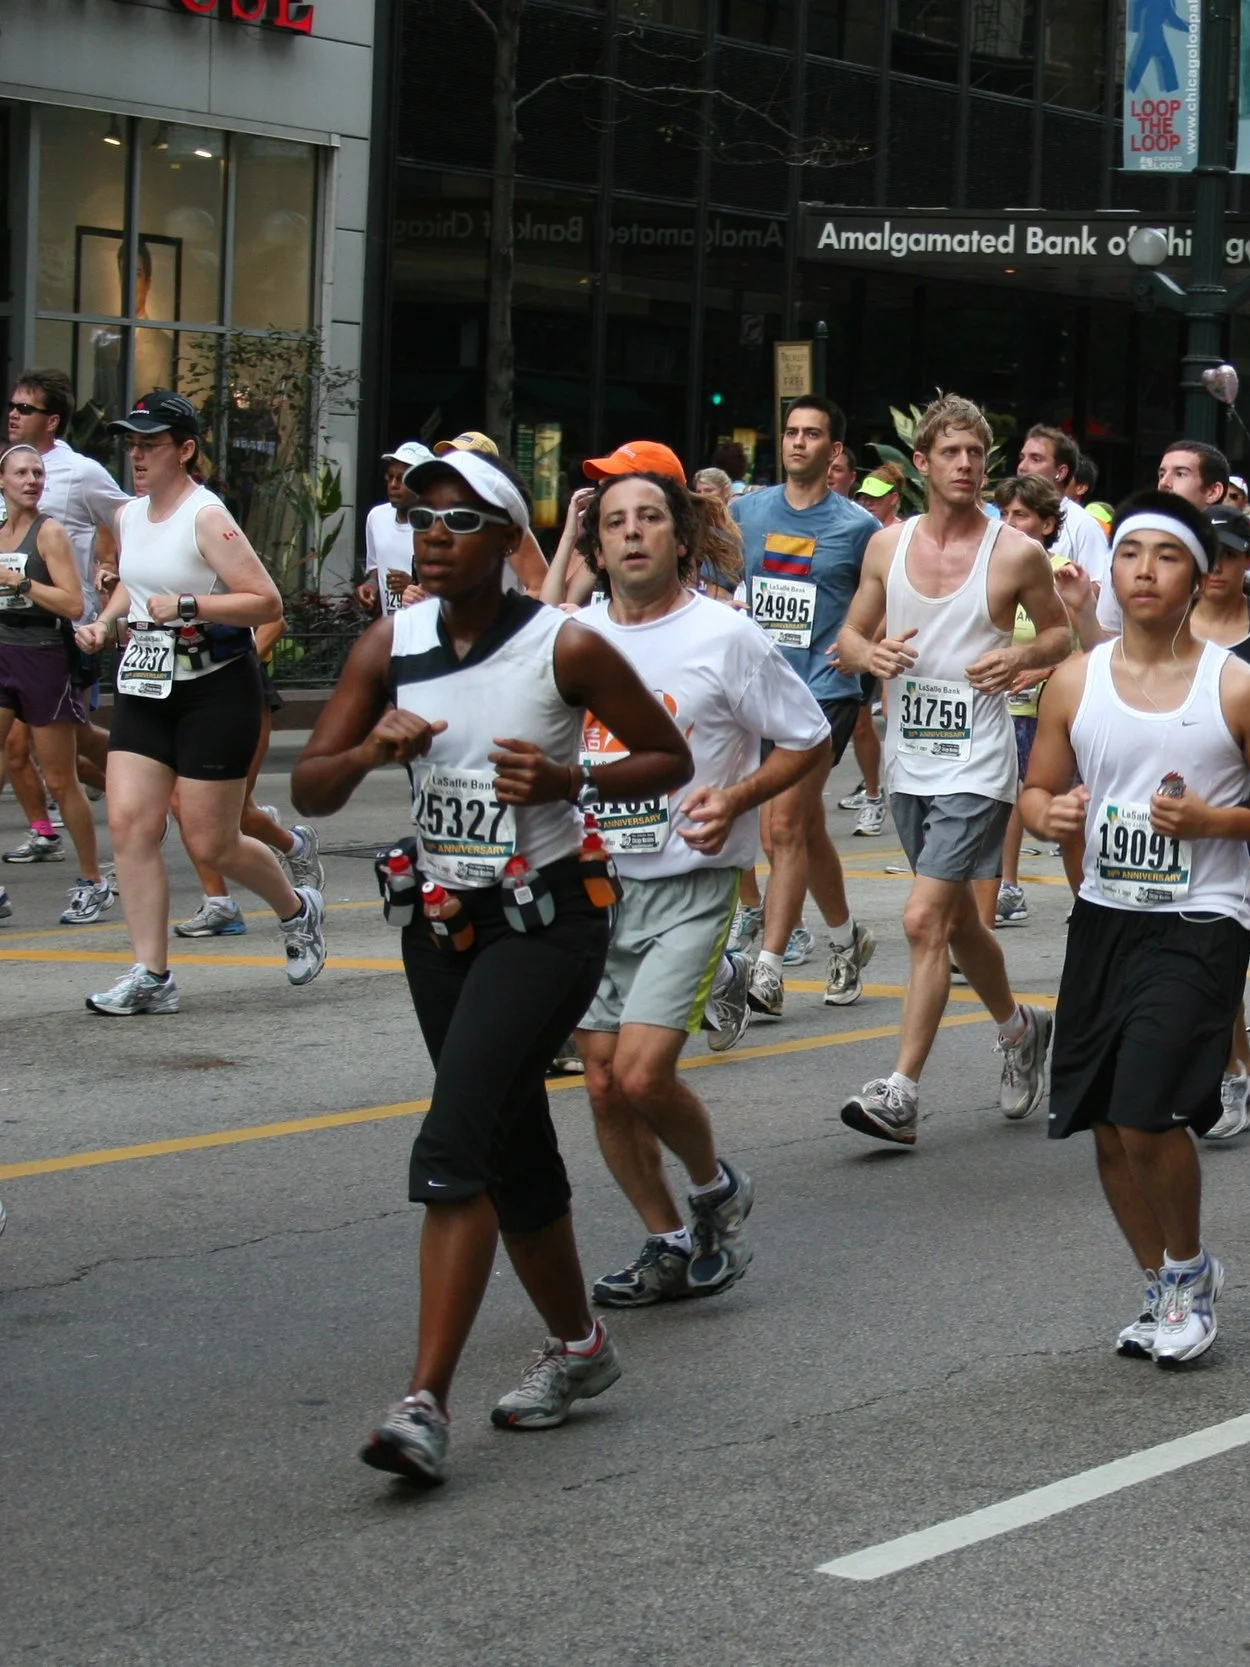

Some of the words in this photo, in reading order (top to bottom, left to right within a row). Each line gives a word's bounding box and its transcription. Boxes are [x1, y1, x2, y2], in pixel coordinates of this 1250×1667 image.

[1130, 100, 1181, 118] LOOP
[1139, 117, 1173, 135] THE
[1130, 135, 1181, 152] LOOP
[1153, 161, 1183, 169] LOOP
[817, 222, 1015, 257] Amalgamated
[1026, 226, 1098, 256] Bank
[755, 592, 811, 622] 24995
[918, 683, 941, 693] LaSalle
[901, 694, 967, 730] 31759
[432, 775, 468, 789] LaSalle
[603, 814, 662, 828] ANNIVERSARY
[438, 845, 506, 855] ANNIVERSARY
[1100, 822, 1182, 871] 19091
[1122, 871, 1182, 882] ANNIVERSARY
